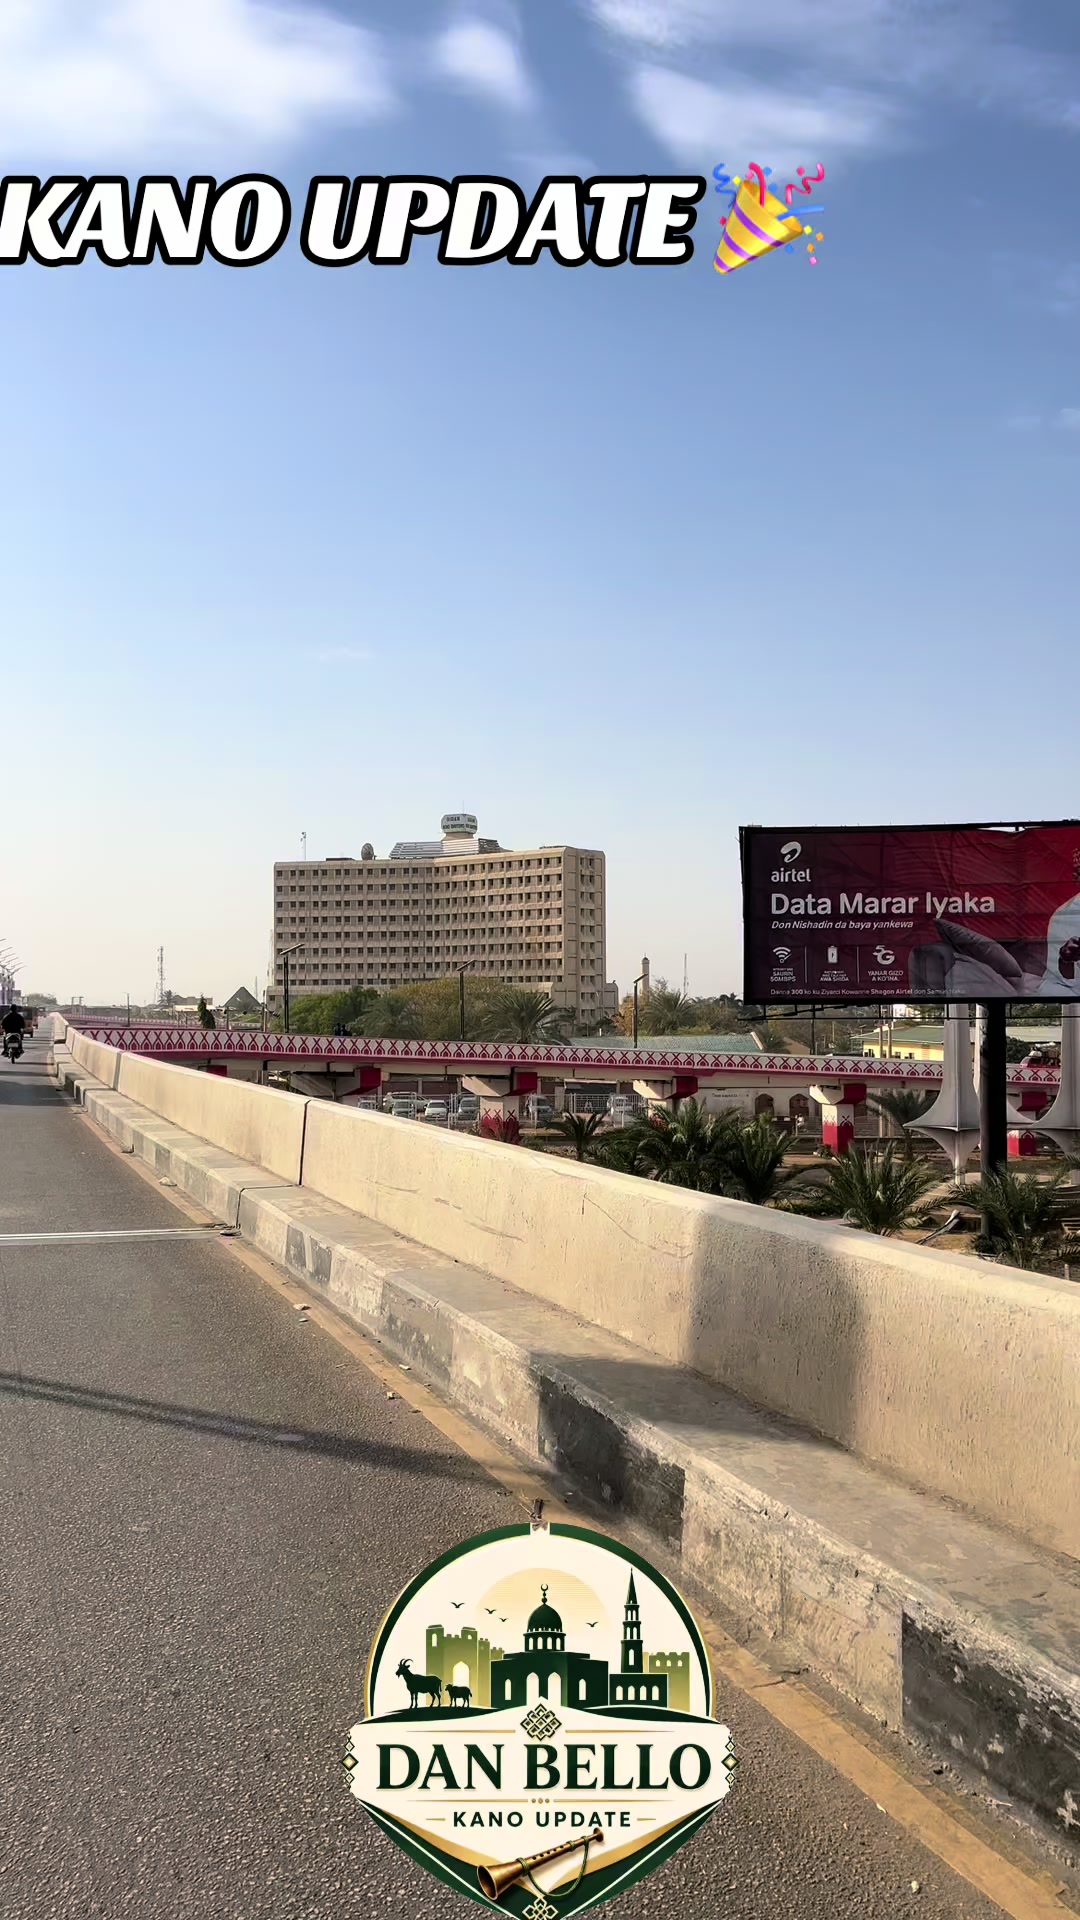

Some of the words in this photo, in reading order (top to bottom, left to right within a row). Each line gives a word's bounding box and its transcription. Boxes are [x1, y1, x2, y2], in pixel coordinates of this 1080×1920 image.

[770, 867, 812, 883] airtel
[770, 893, 832, 915] Data
[839, 892, 919, 915] Marar
[926, 891, 996, 919] Iyaka
[771, 920, 791, 929] Don
[792, 919, 833, 929] Nishadin
[834, 919, 847, 929] da
[848, 919, 871, 931] baya
[872, 919, 914, 931] yankewa
[872, 945, 896, 965] 5G
